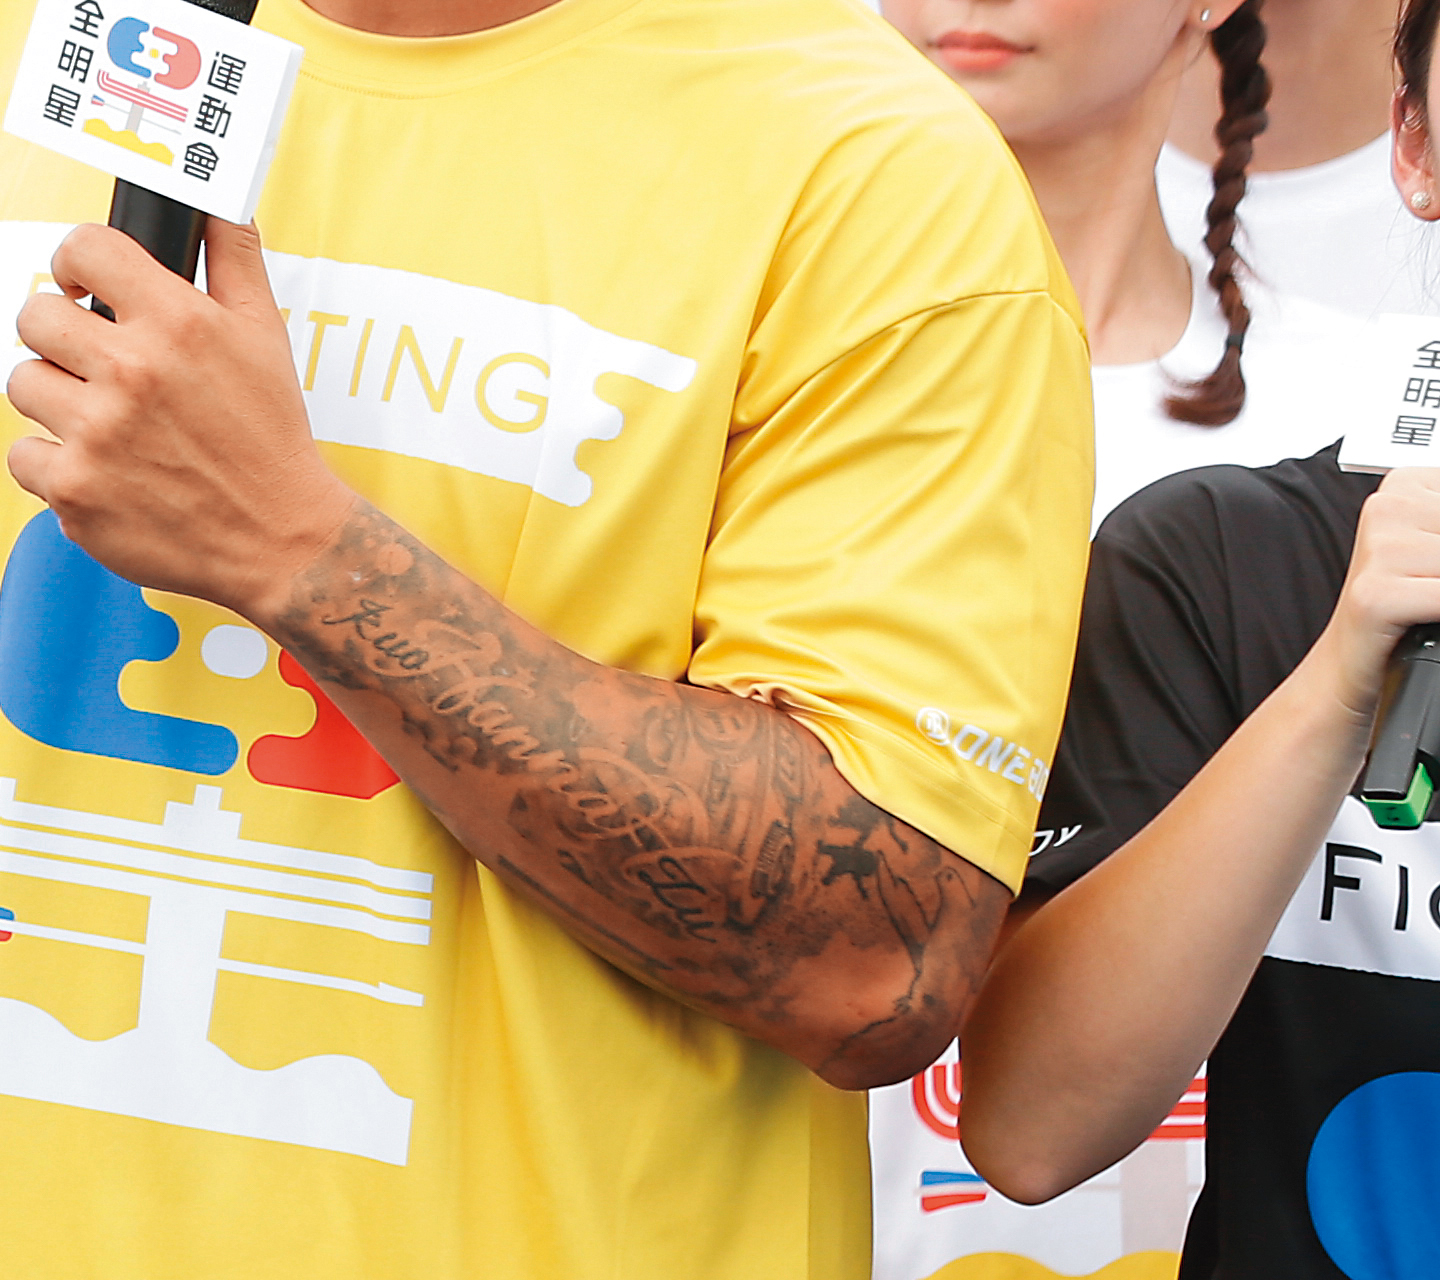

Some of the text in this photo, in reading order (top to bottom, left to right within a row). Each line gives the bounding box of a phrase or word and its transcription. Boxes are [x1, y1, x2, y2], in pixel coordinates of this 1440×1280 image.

[43, 0, 104, 128] 全明星
[183, 51, 246, 181] 運動會
